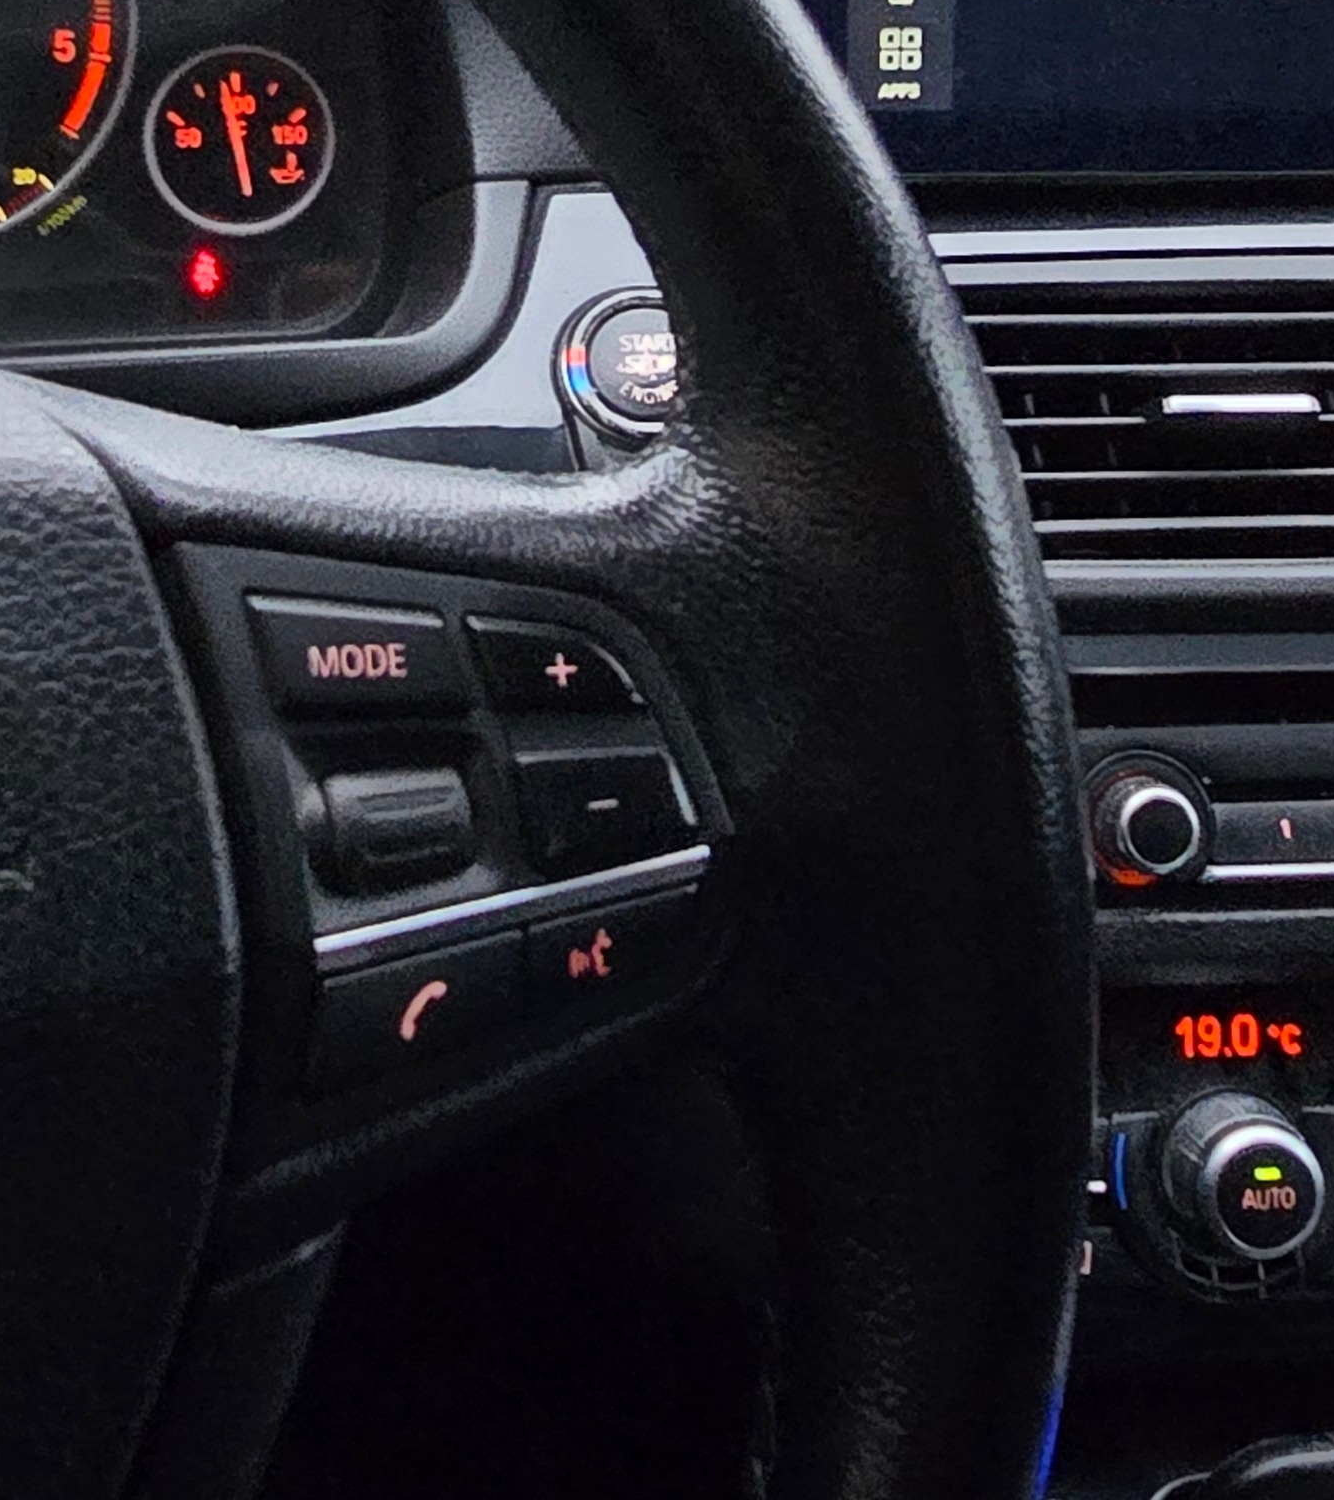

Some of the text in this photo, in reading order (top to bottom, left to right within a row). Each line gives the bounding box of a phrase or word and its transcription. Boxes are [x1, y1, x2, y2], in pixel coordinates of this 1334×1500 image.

[53, 30, 75, 62] 5
[175, 125, 202, 148] 50
[272, 122, 307, 145] 150
[13, 168, 37, 185] 20
[308, 643, 406, 677] MODE
[1280, 819, 1291, 838] 1
[1242, 1187, 1295, 1210] AUTO
